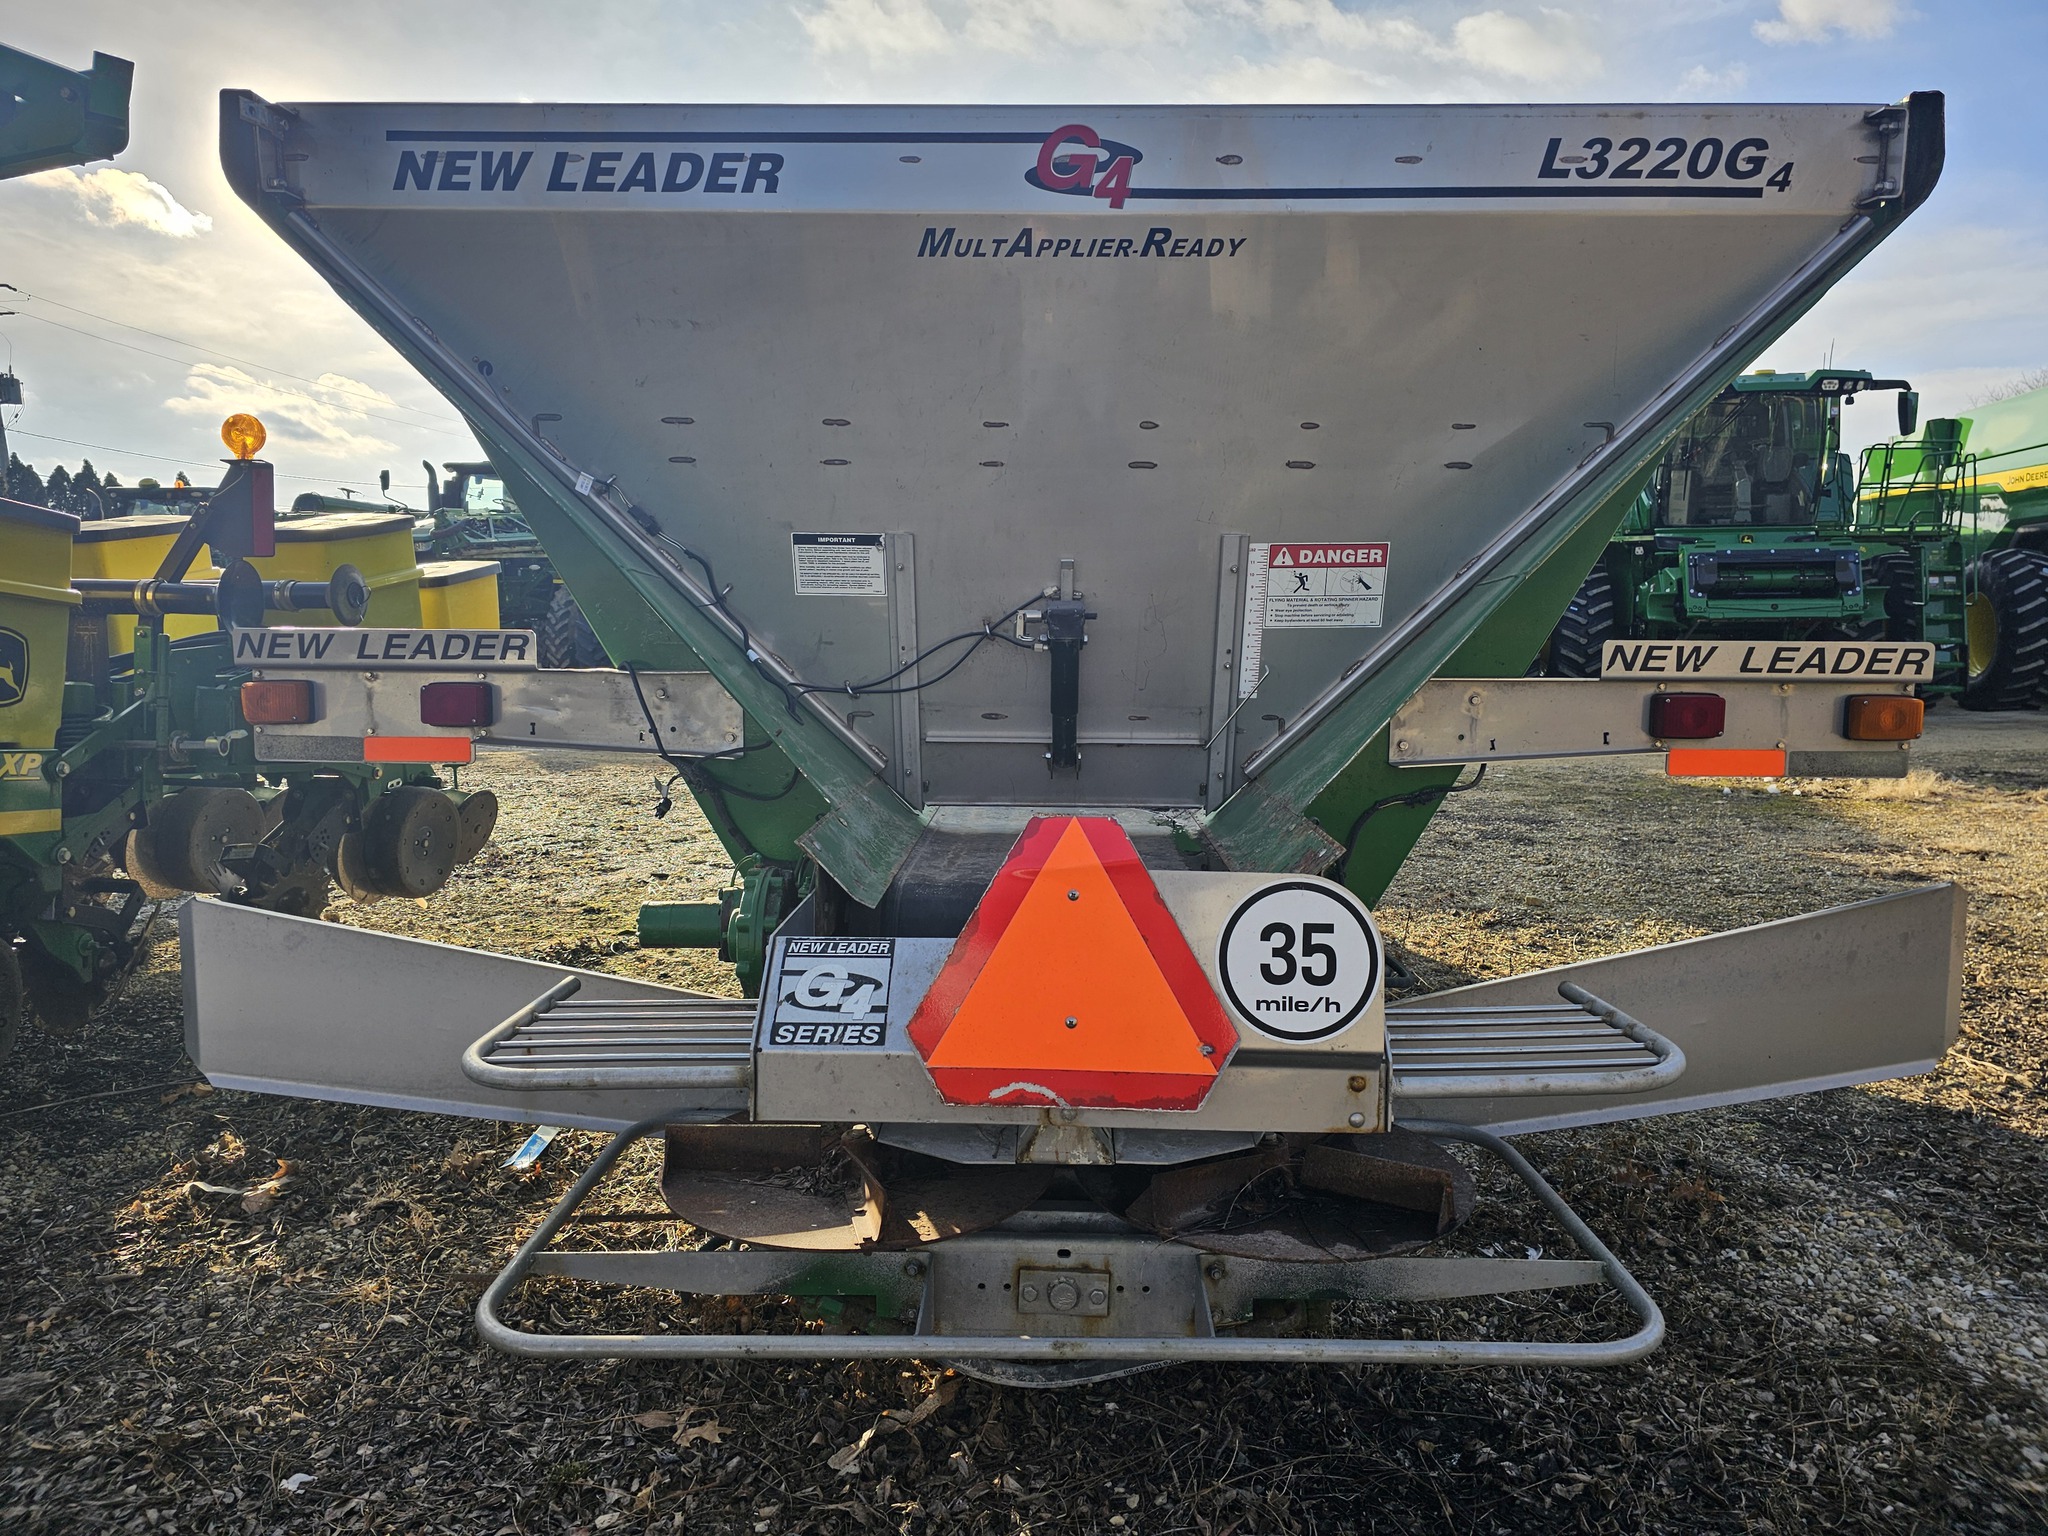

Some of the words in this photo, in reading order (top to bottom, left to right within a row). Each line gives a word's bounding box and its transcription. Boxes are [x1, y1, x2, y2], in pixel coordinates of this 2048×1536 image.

[392, 150, 534, 191] NEW
[546, 151, 785, 194] LEADER
[1037, 124, 1134, 210] G4
[2007, 475, 2025, 485] JOHN
[1299, 549, 1383, 564] DANGER
[237, 633, 335, 659] NEW
[356, 633, 530, 660] LEADER
[1606, 645, 1718, 672] NEW
[1739, 646, 1930, 675] LEADER
[788, 942, 826, 953] NEW
[827, 943, 890, 954] LEADER
[1260, 922, 1337, 986] 35
[794, 964, 876, 1020] G4
[1256, 996, 1341, 1013] mile/h
[775, 1025, 881, 1044] SERIES
